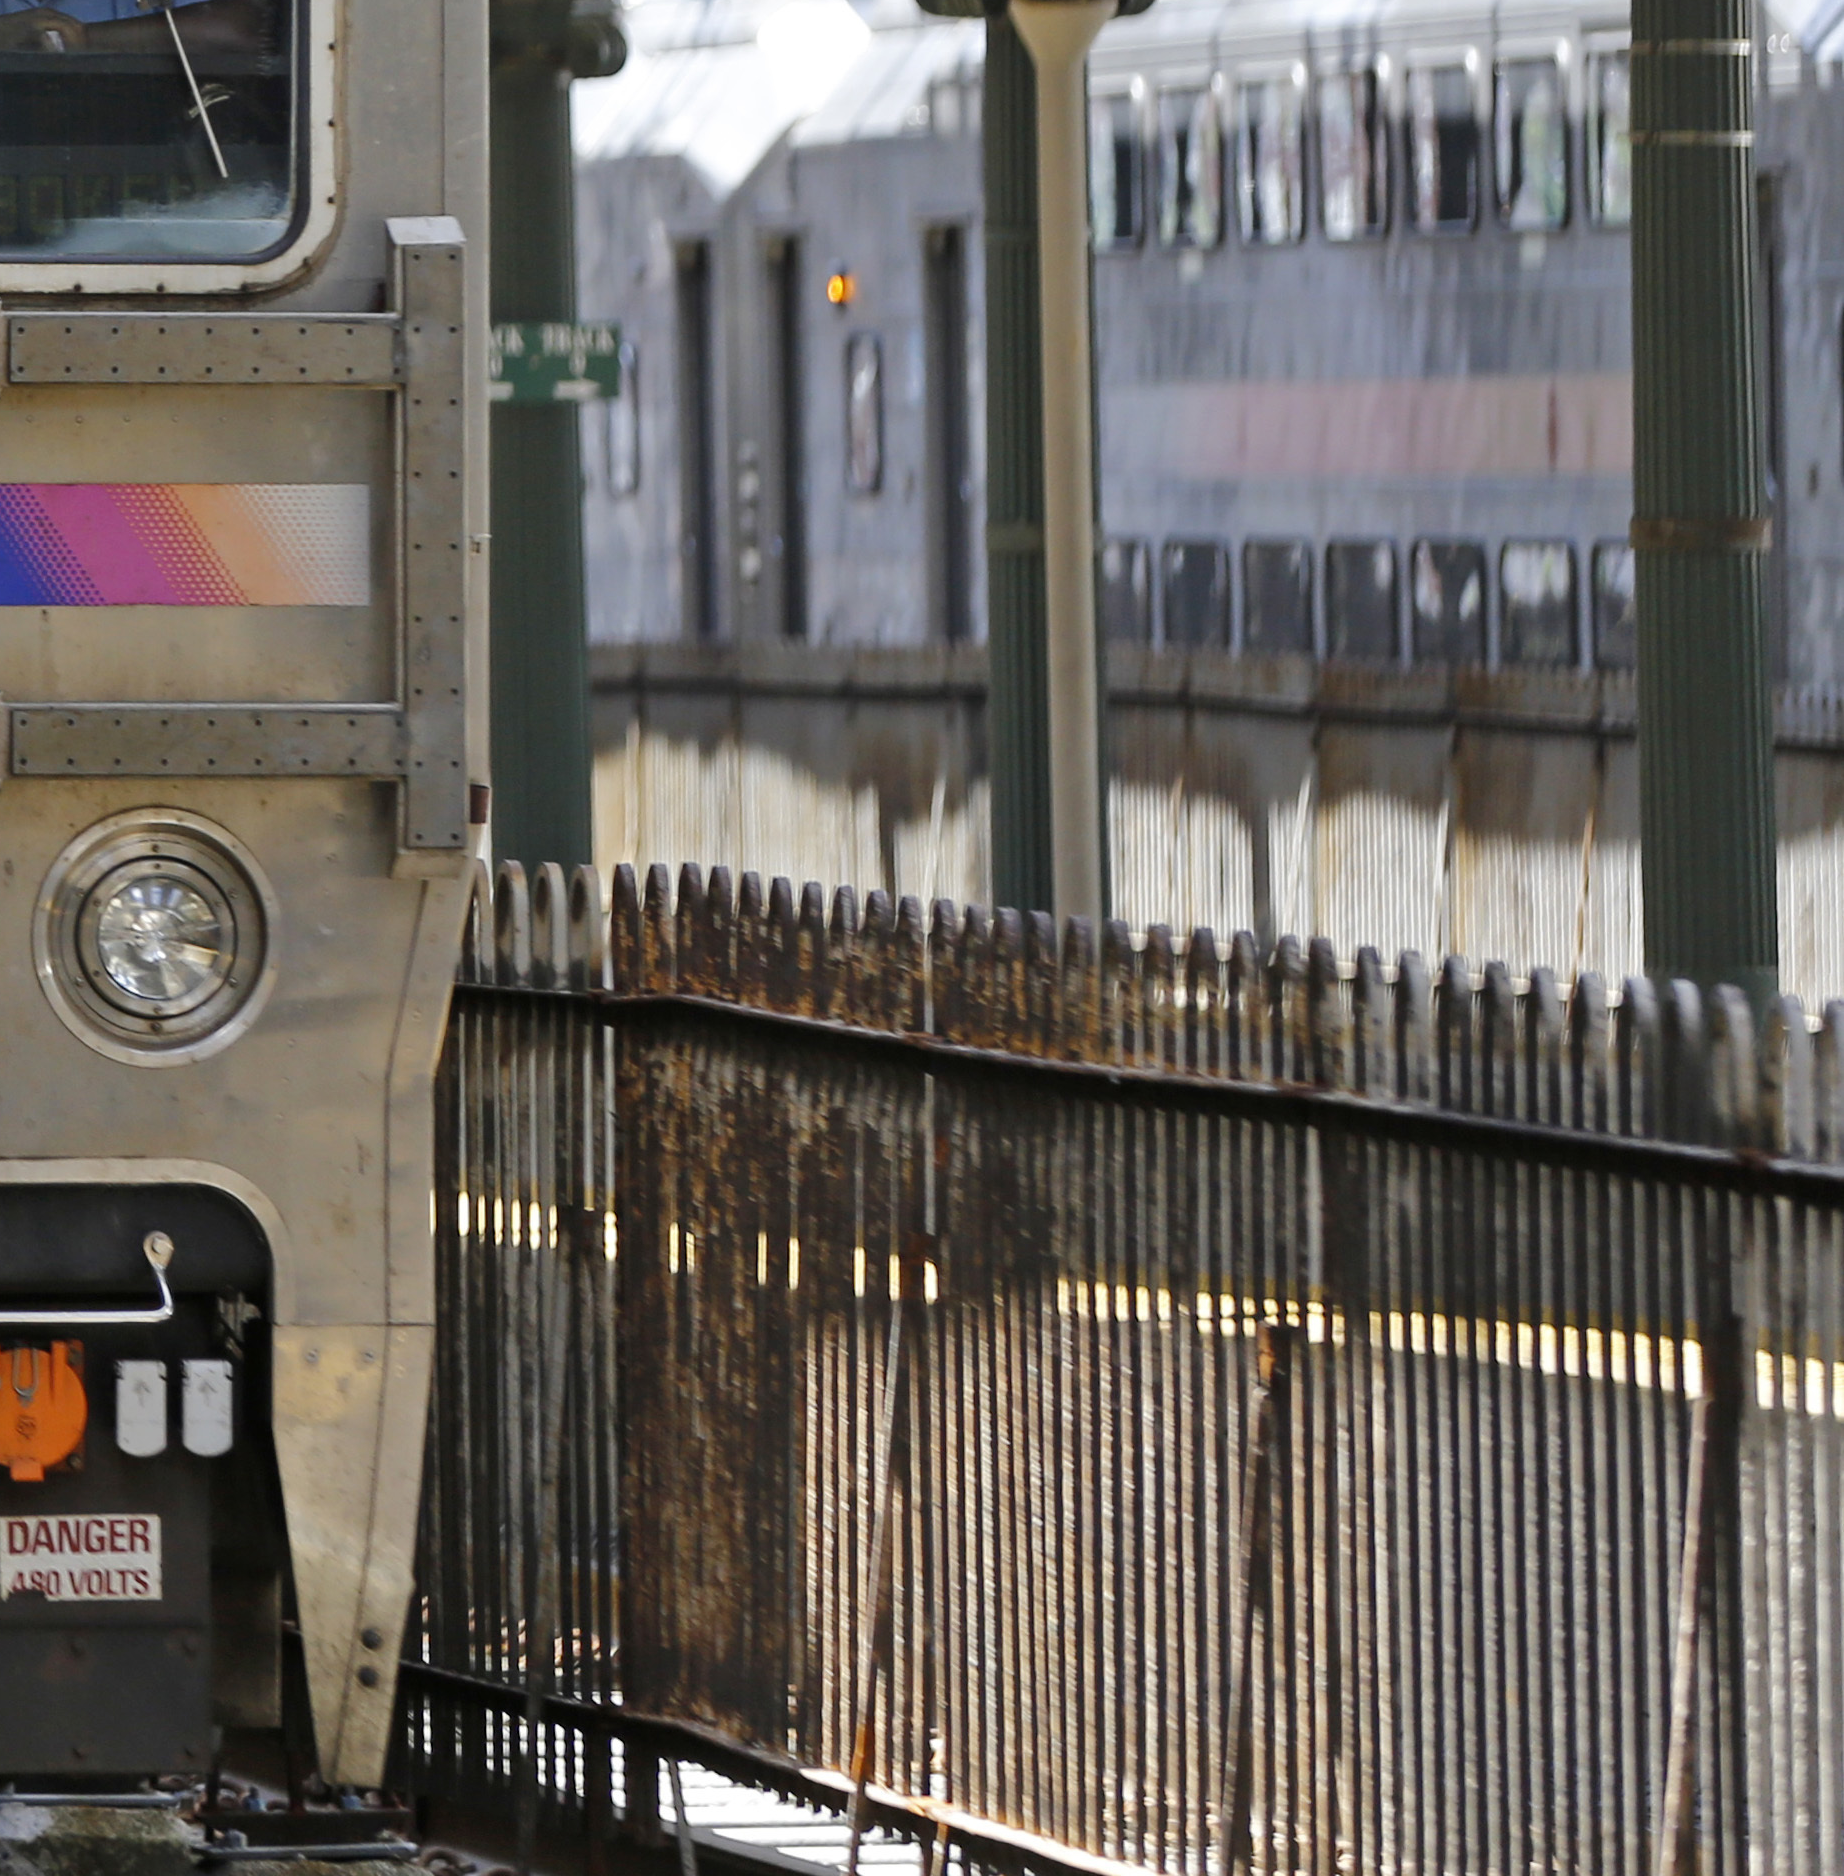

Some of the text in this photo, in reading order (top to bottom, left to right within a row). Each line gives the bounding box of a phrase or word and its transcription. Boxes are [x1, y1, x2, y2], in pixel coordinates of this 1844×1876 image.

[6, 1519, 152, 1554] DANGER
[12, 1569, 150, 1596] 480 VOLTS
